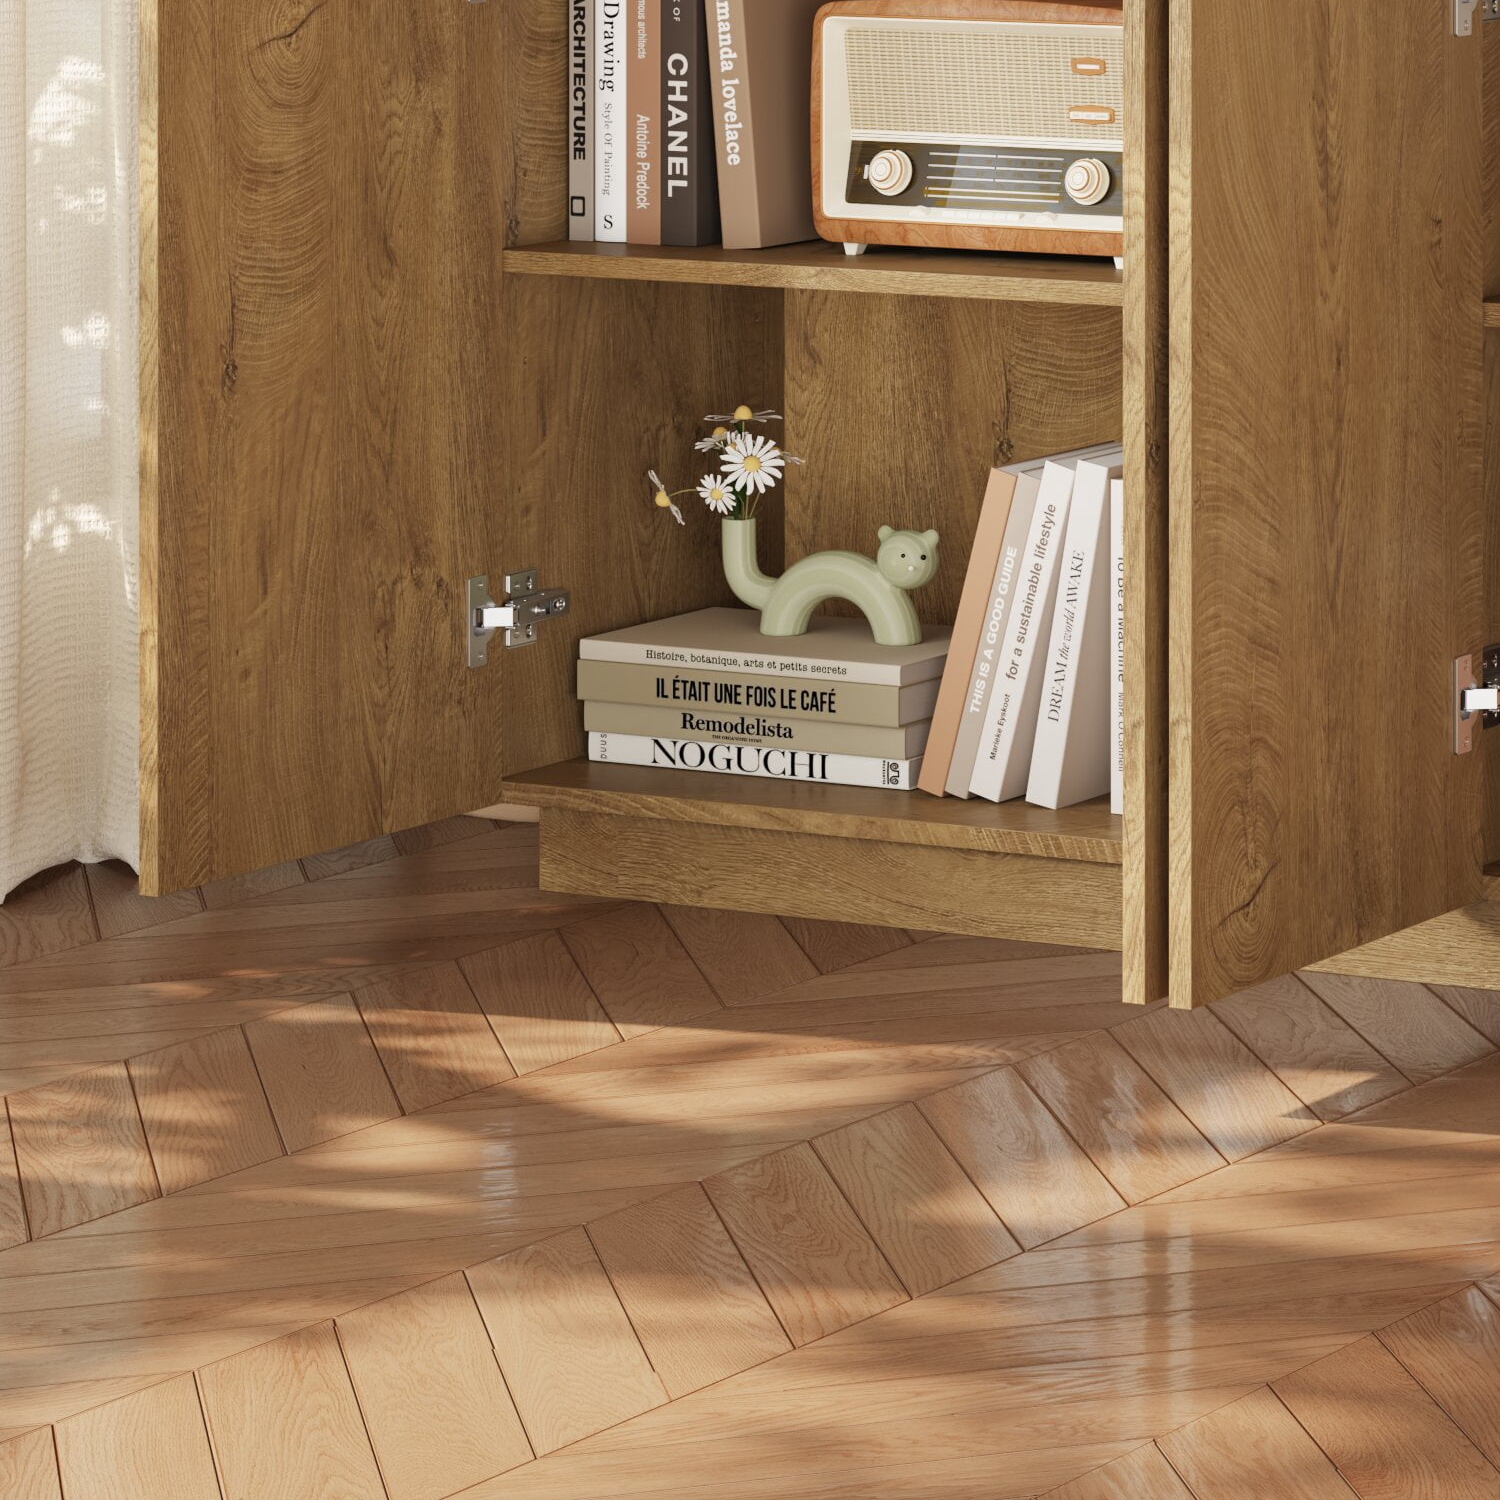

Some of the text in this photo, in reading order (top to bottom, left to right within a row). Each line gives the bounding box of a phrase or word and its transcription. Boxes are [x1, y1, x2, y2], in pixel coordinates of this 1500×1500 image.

[673, 7, 680, 22] OF
[599, 3, 620, 92] Drawing
[638, 21, 647, 59] architects
[667, 53, 689, 198] CHANEL
[722, 78, 744, 166] lovelace
[602, 152, 613, 196] Painting
[636, 114, 650, 209] Antoine Predock
[603, 214, 614, 230] S
[970, 546, 1018, 714] THIS IS A GOOD GUIDE
[990, 503, 1057, 761] Marieke Eyskoot for a sustainable lifestyle
[1047, 550, 1085, 723] DREAM the world AWAKE
[646, 649, 848, 676] Histoire, botanique, arts et petits secrets
[656, 675, 837, 713] IL ÉTAIT UNE FOIS LE CAFÉ
[681, 713, 794, 739] Remodelista
[650, 738, 829, 779] NOGUCHI
